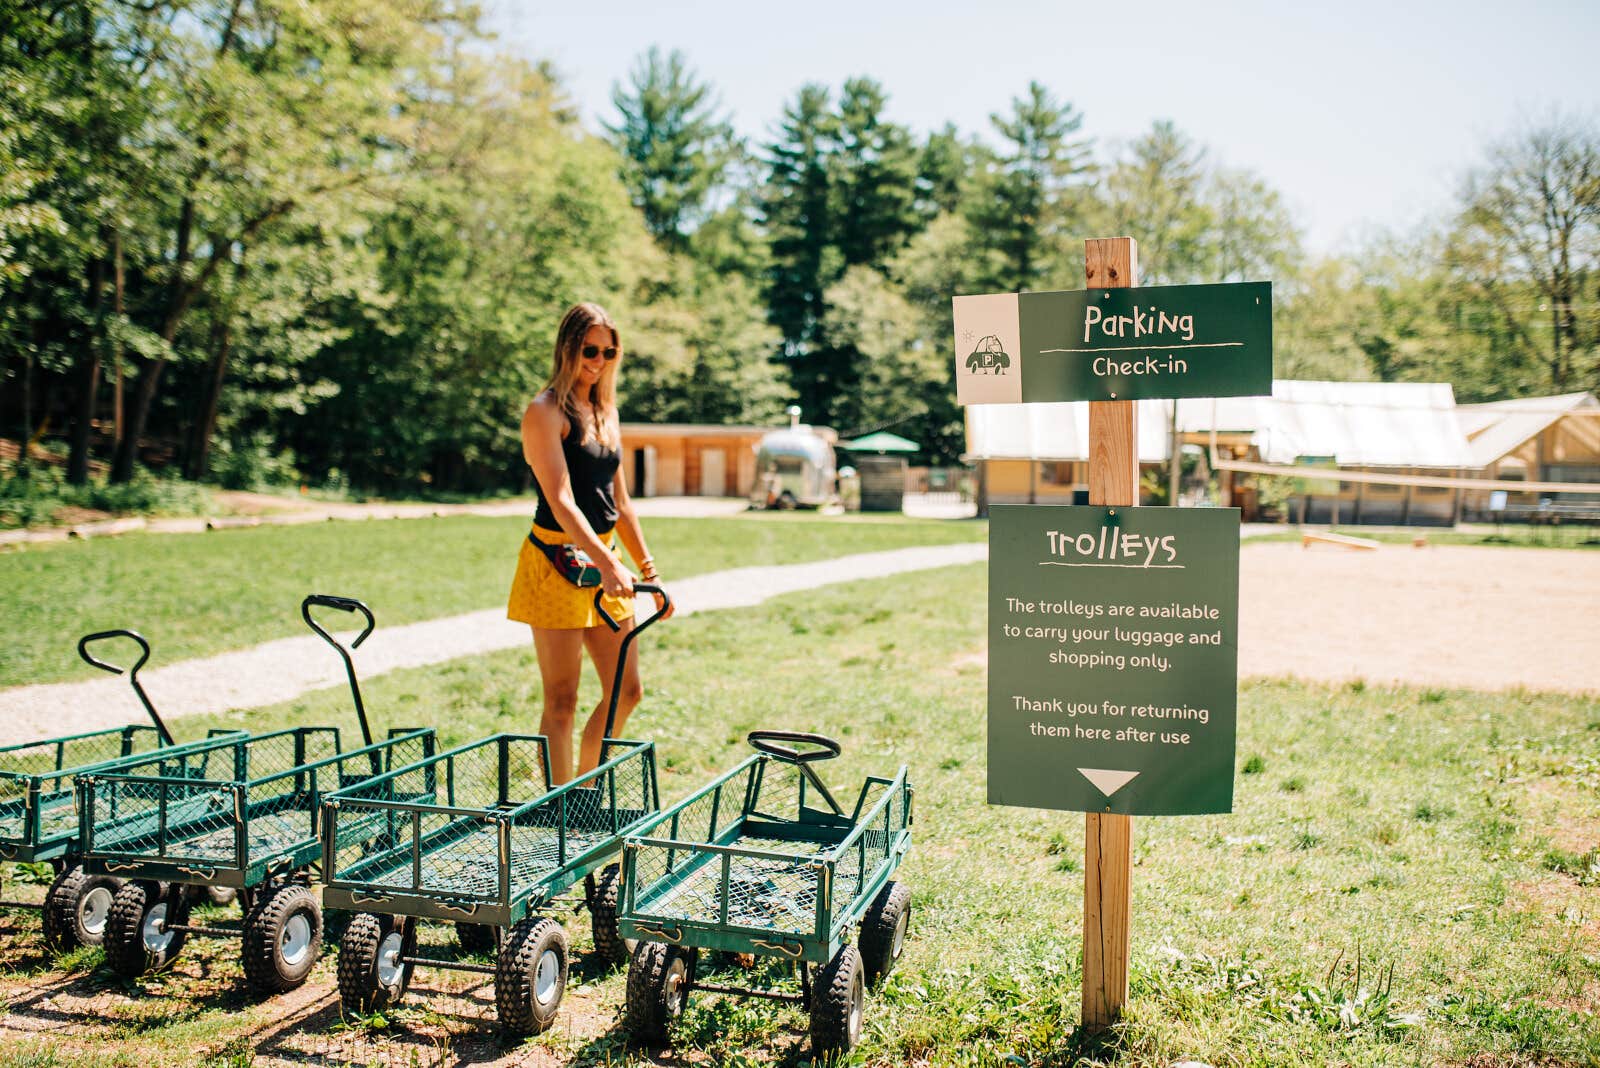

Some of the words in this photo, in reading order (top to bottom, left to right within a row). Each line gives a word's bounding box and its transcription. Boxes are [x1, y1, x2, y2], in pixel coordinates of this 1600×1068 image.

[1092, 354, 1187, 376] Check-in
[1006, 598, 1035, 613] The
[1039, 600, 1103, 618] trolleys
[1108, 605, 1134, 617] are
[1139, 603, 1219, 619] available
[1003, 623, 1021, 637] to
[1025, 626, 1067, 642] carry
[1072, 628, 1110, 643] your
[1115, 626, 1184, 646] luggage
[1188, 631, 1221, 645] and
[1049, 649, 1125, 670] shopping
[1130, 653, 1172, 672] only.
[1012, 696, 1063, 713] Thank
[1067, 702, 1098, 717] you
[1102, 701, 1126, 716] for
[1131, 704, 1209, 724] returning
[1029, 722, 1071, 737] them
[1075, 724, 1111, 740] here
[1115, 727, 1156, 743] after
[1160, 732, 1191, 744] use
